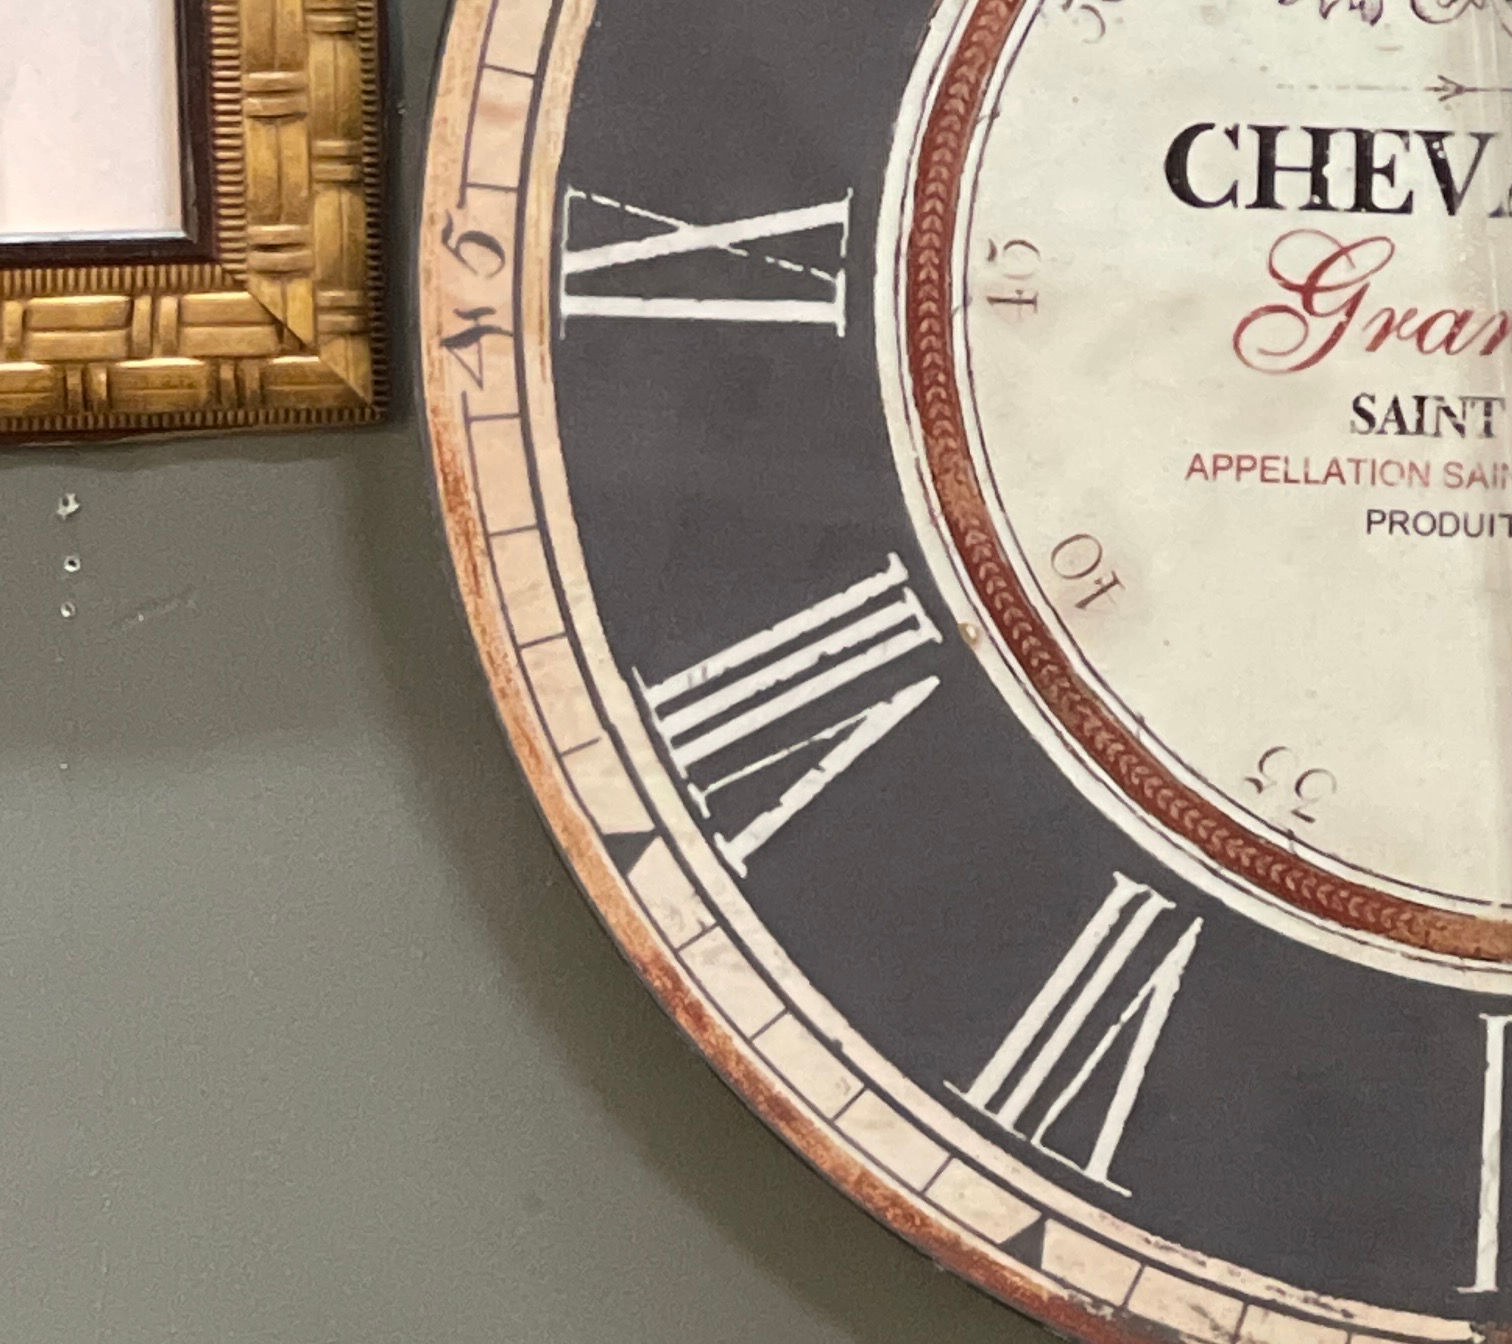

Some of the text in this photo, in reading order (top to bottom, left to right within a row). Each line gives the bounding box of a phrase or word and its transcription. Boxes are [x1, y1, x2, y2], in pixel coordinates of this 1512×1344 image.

[439, 211, 512, 389] 45
[559, 186, 853, 339] IX
[987, 239, 1040, 314] 45
[1184, 452, 1430, 490] APPELLATION
[1050, 532, 1126, 611] 40
[631, 552, 942, 878] VIII
[1242, 745, 1338, 824] 35
[943, 871, 1204, 1197] VII
